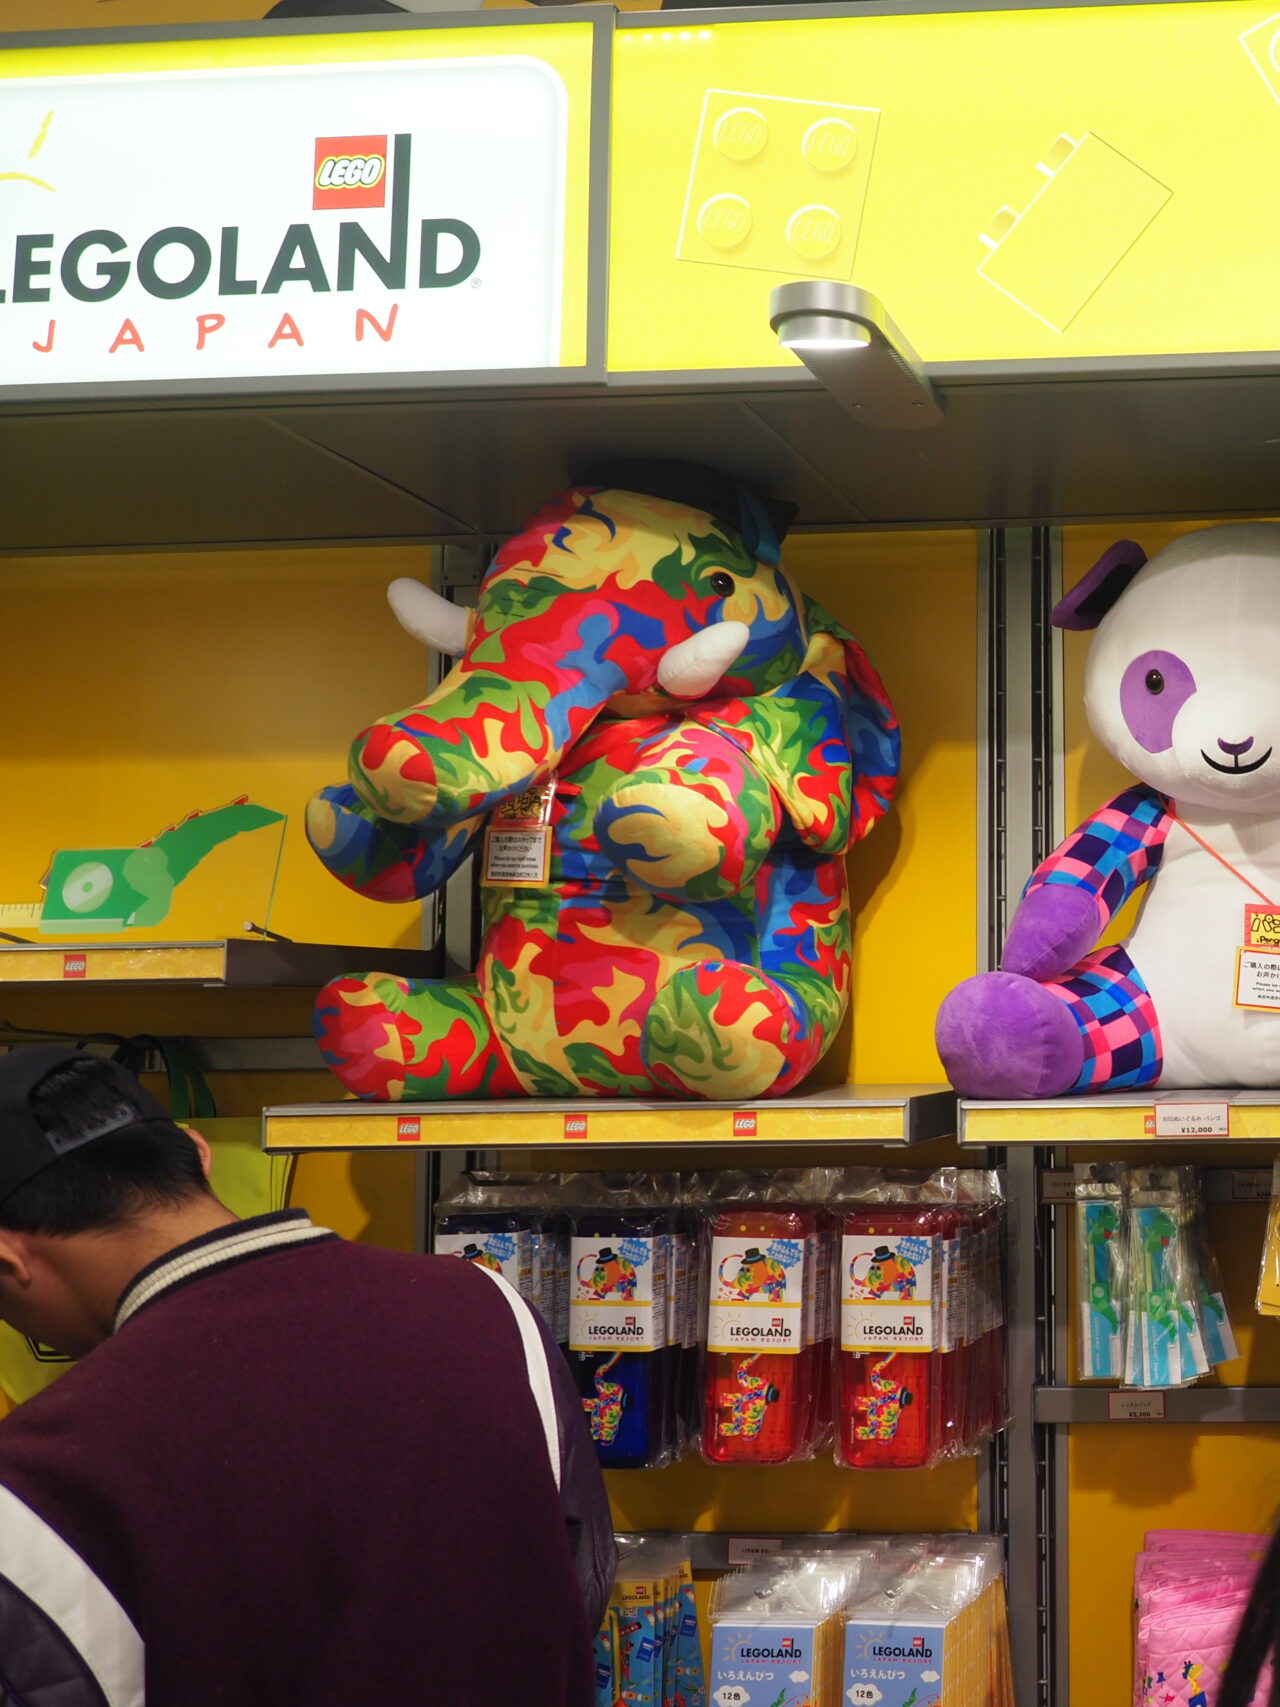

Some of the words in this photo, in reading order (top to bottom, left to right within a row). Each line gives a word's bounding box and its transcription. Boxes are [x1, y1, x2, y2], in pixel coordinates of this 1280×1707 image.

[316, 156, 384, 189] LEGO
[0, 134, 481, 303] EGOLAND
[32, 303, 399, 354] JAPAN
[399, 1124, 419, 1134] LEGO
[566, 1122, 586, 1132] LEGO
[735, 1119, 755, 1129] LEGO
[589, 1317, 644, 1335] LEGOLAND
[730, 1318, 791, 1337] LEGOLAND
[863, 1317, 923, 1335] LEGOLAND
[741, 1638, 802, 1658] LEGOLAND
[873, 1637, 932, 1658] LEGOLAND
[717, 1671, 774, 1681] いろえんぴつ
[850, 1668, 905, 1680] いろえんぴつ
[722, 1692, 741, 1701] 12色
[856, 1691, 874, 1699] 12色
